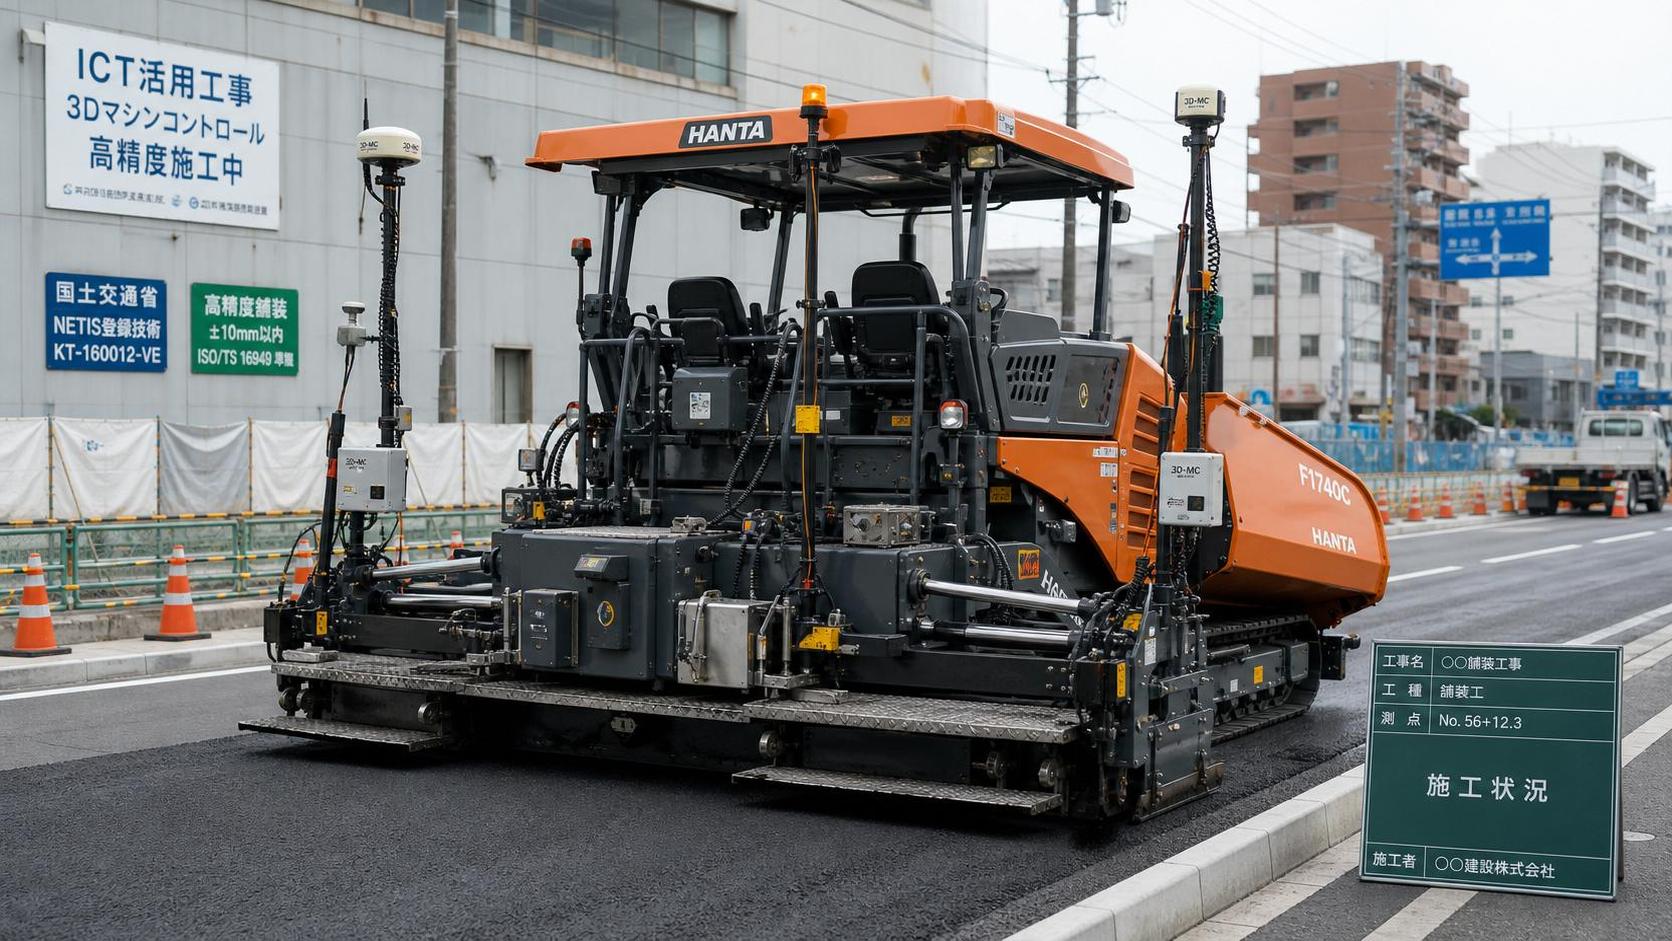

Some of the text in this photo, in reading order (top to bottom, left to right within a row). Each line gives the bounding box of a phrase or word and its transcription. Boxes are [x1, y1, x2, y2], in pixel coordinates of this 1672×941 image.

[78, 48, 252, 107] ICT活用工事
[66, 94, 264, 145] 3Dマシンコントロール
[687, 120, 765, 144] HANTA
[90, 135, 243, 186] 高精度施工中
[56, 280, 158, 308] 国土交通省
[204, 294, 288, 319] 高精度舗装
[209, 324, 284, 343] ±10mm以内
[54, 343, 161, 364] KT-160012-VE
[198, 348, 238, 365] ISO/TS
[240, 350, 272, 366] 16949
[1298, 462, 1351, 506] F1740C
[1311, 526, 1357, 555] HANTA
[1382, 654, 1424, 669] 工事名
[1440, 684, 1484, 699] 舗装工
[1439, 714, 1522, 729] No. 56+12.3
[1426, 773, 1548, 802] 施工状況
[1372, 851, 1417, 869] 施工者
